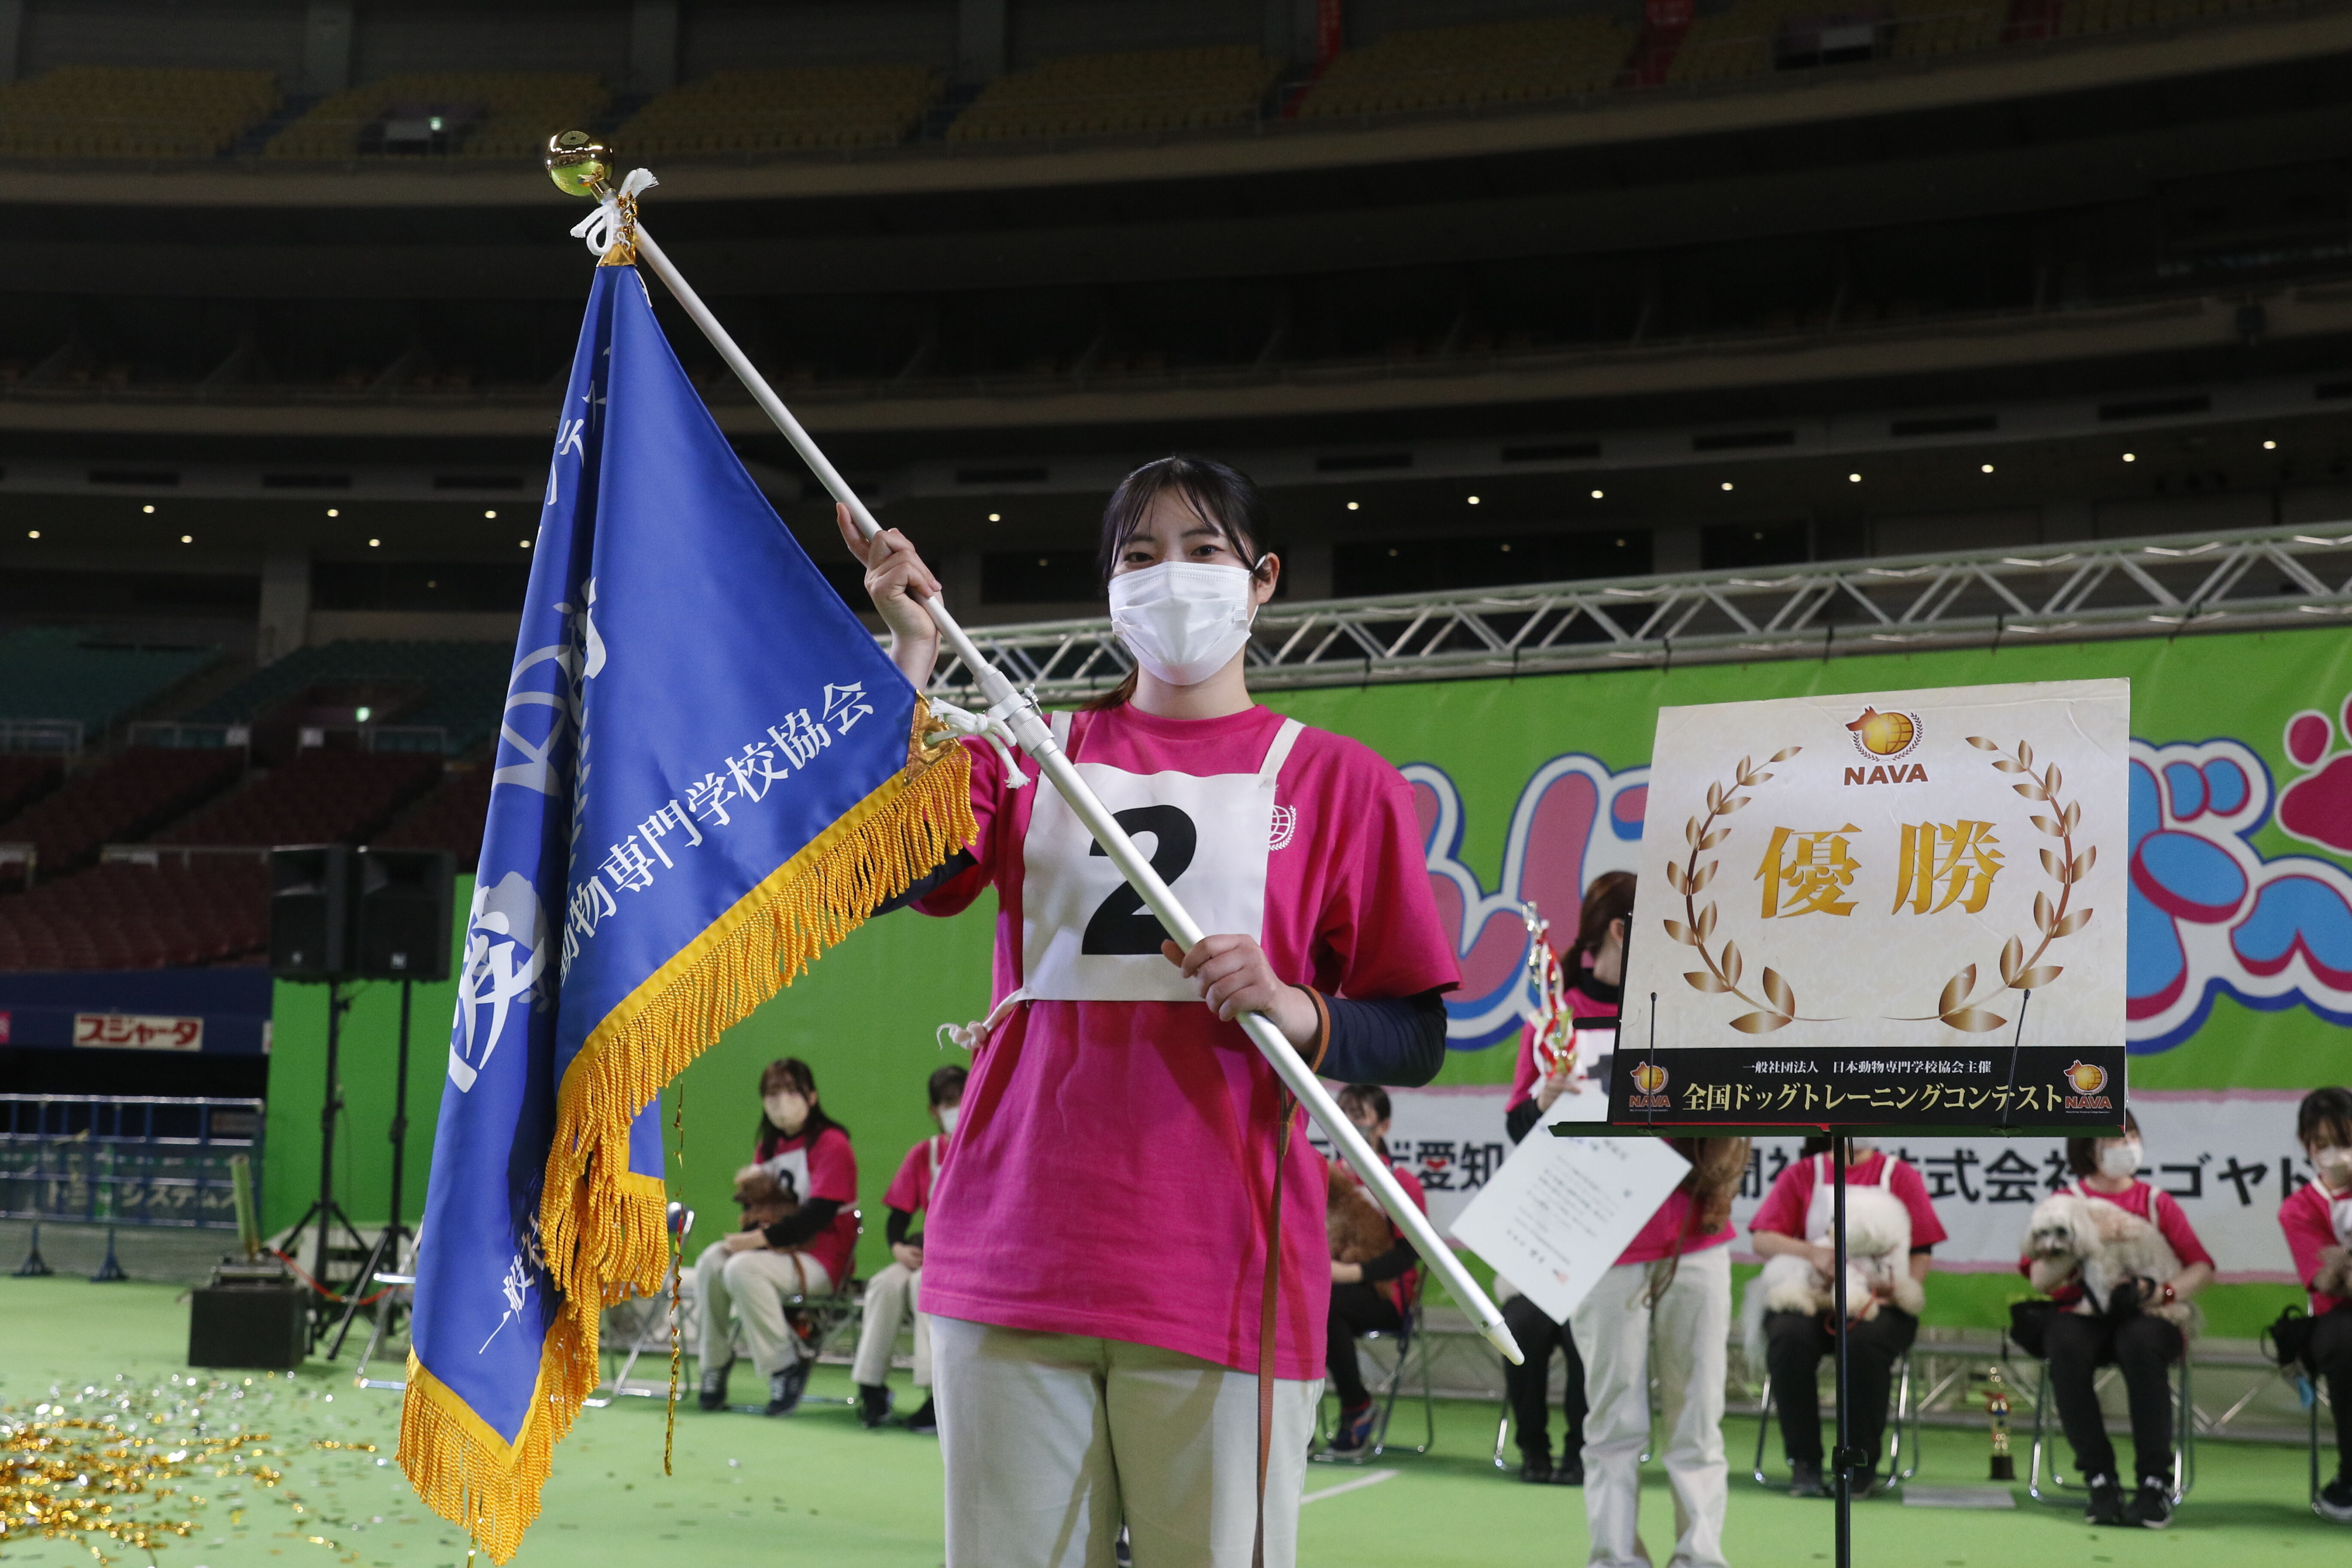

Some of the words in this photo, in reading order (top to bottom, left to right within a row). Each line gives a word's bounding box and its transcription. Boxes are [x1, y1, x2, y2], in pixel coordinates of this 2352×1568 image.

[1844, 763, 1929, 786] NAVA
[1081, 805, 1197, 955] 2
[1753, 818, 2006, 919] 優勝
[79, 1017, 198, 1045] スジャータ
[1742, 1061, 1819, 1074] 一般社団法人
[1832, 1060, 1992, 1074] 日本動物専門学校協会主催
[1629, 1095, 1671, 1108] NAVA
[1682, 1081, 2062, 1113] 全国ドッグトレーニングコンテスト
[2065, 1096, 2113, 1109] NAVA
